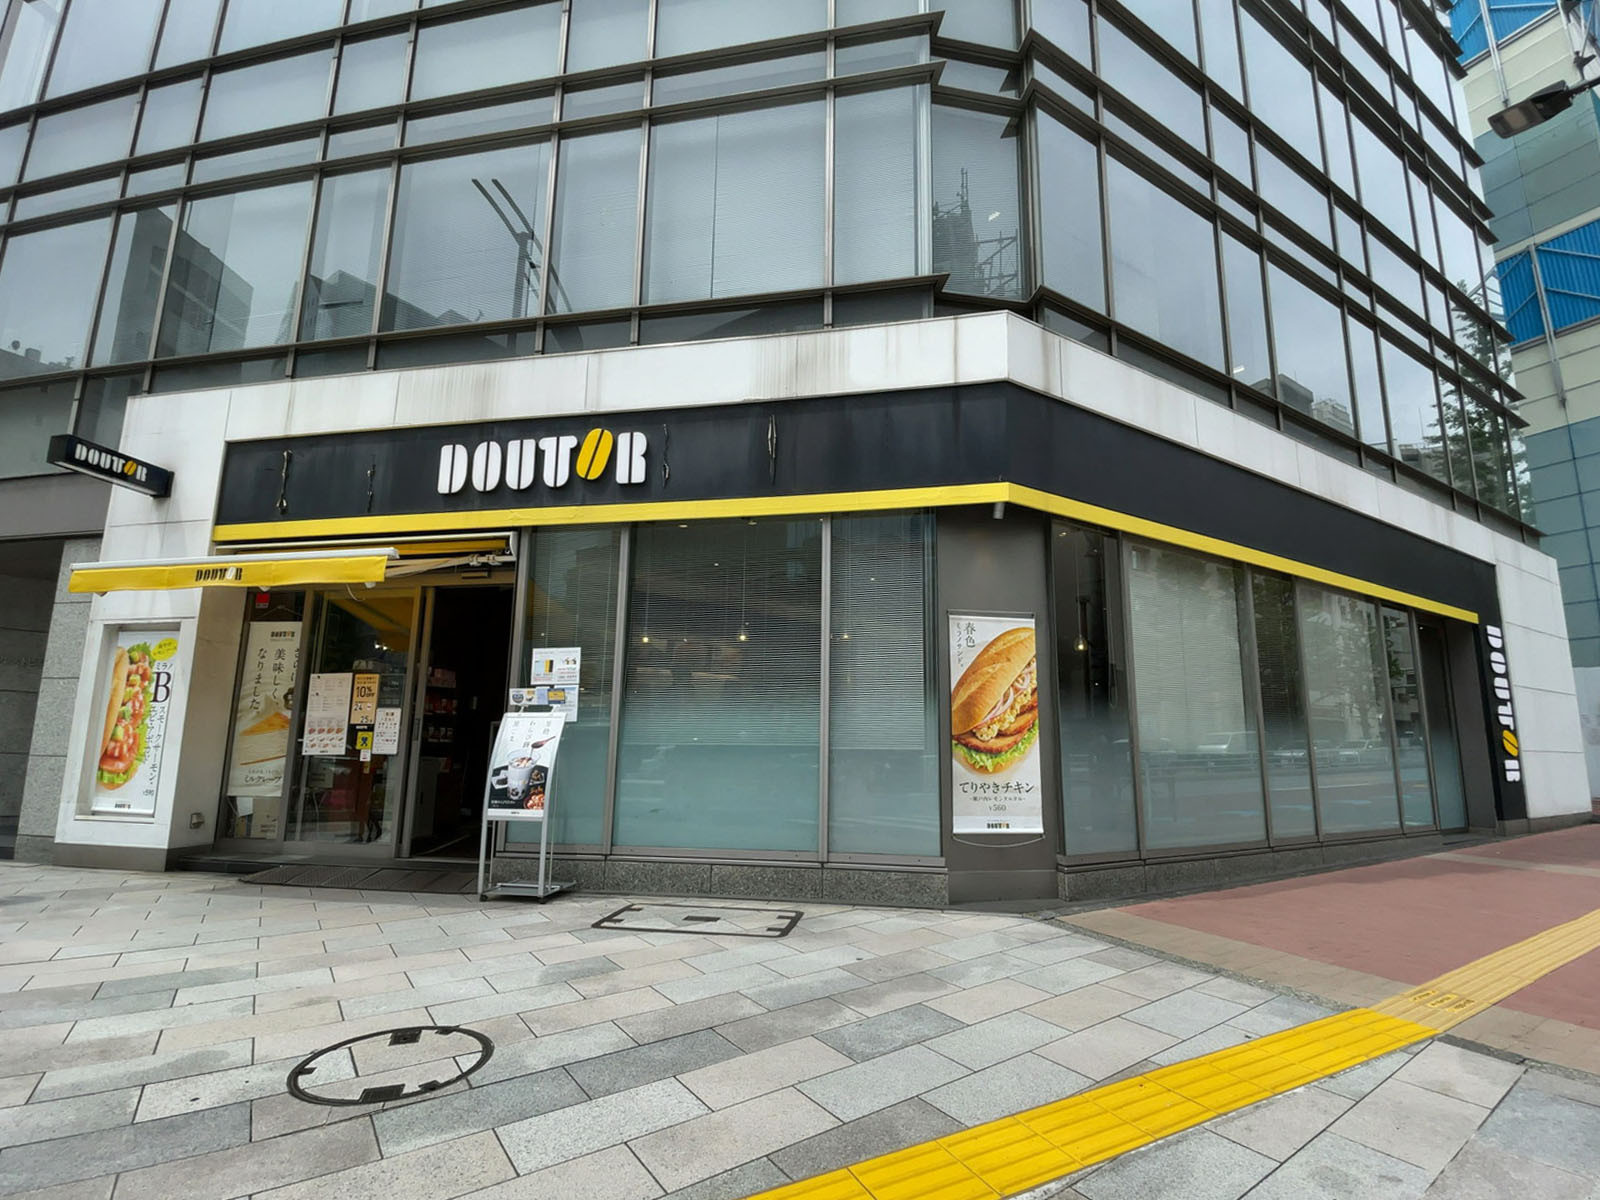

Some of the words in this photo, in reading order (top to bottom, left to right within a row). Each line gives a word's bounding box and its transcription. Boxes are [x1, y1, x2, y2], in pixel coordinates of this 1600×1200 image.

[74, 443, 149, 482] DOUTOR
[437, 428, 648, 495] DOUTOR
[195, 566, 243, 582] DOUTOR
[963, 622, 976, 648] 春色
[149, 671, 172, 703] B
[249, 648, 268, 714] なりました。
[1486, 624, 1521, 782] DOUTOR
[959, 781, 1034, 794] てりやきチキン
